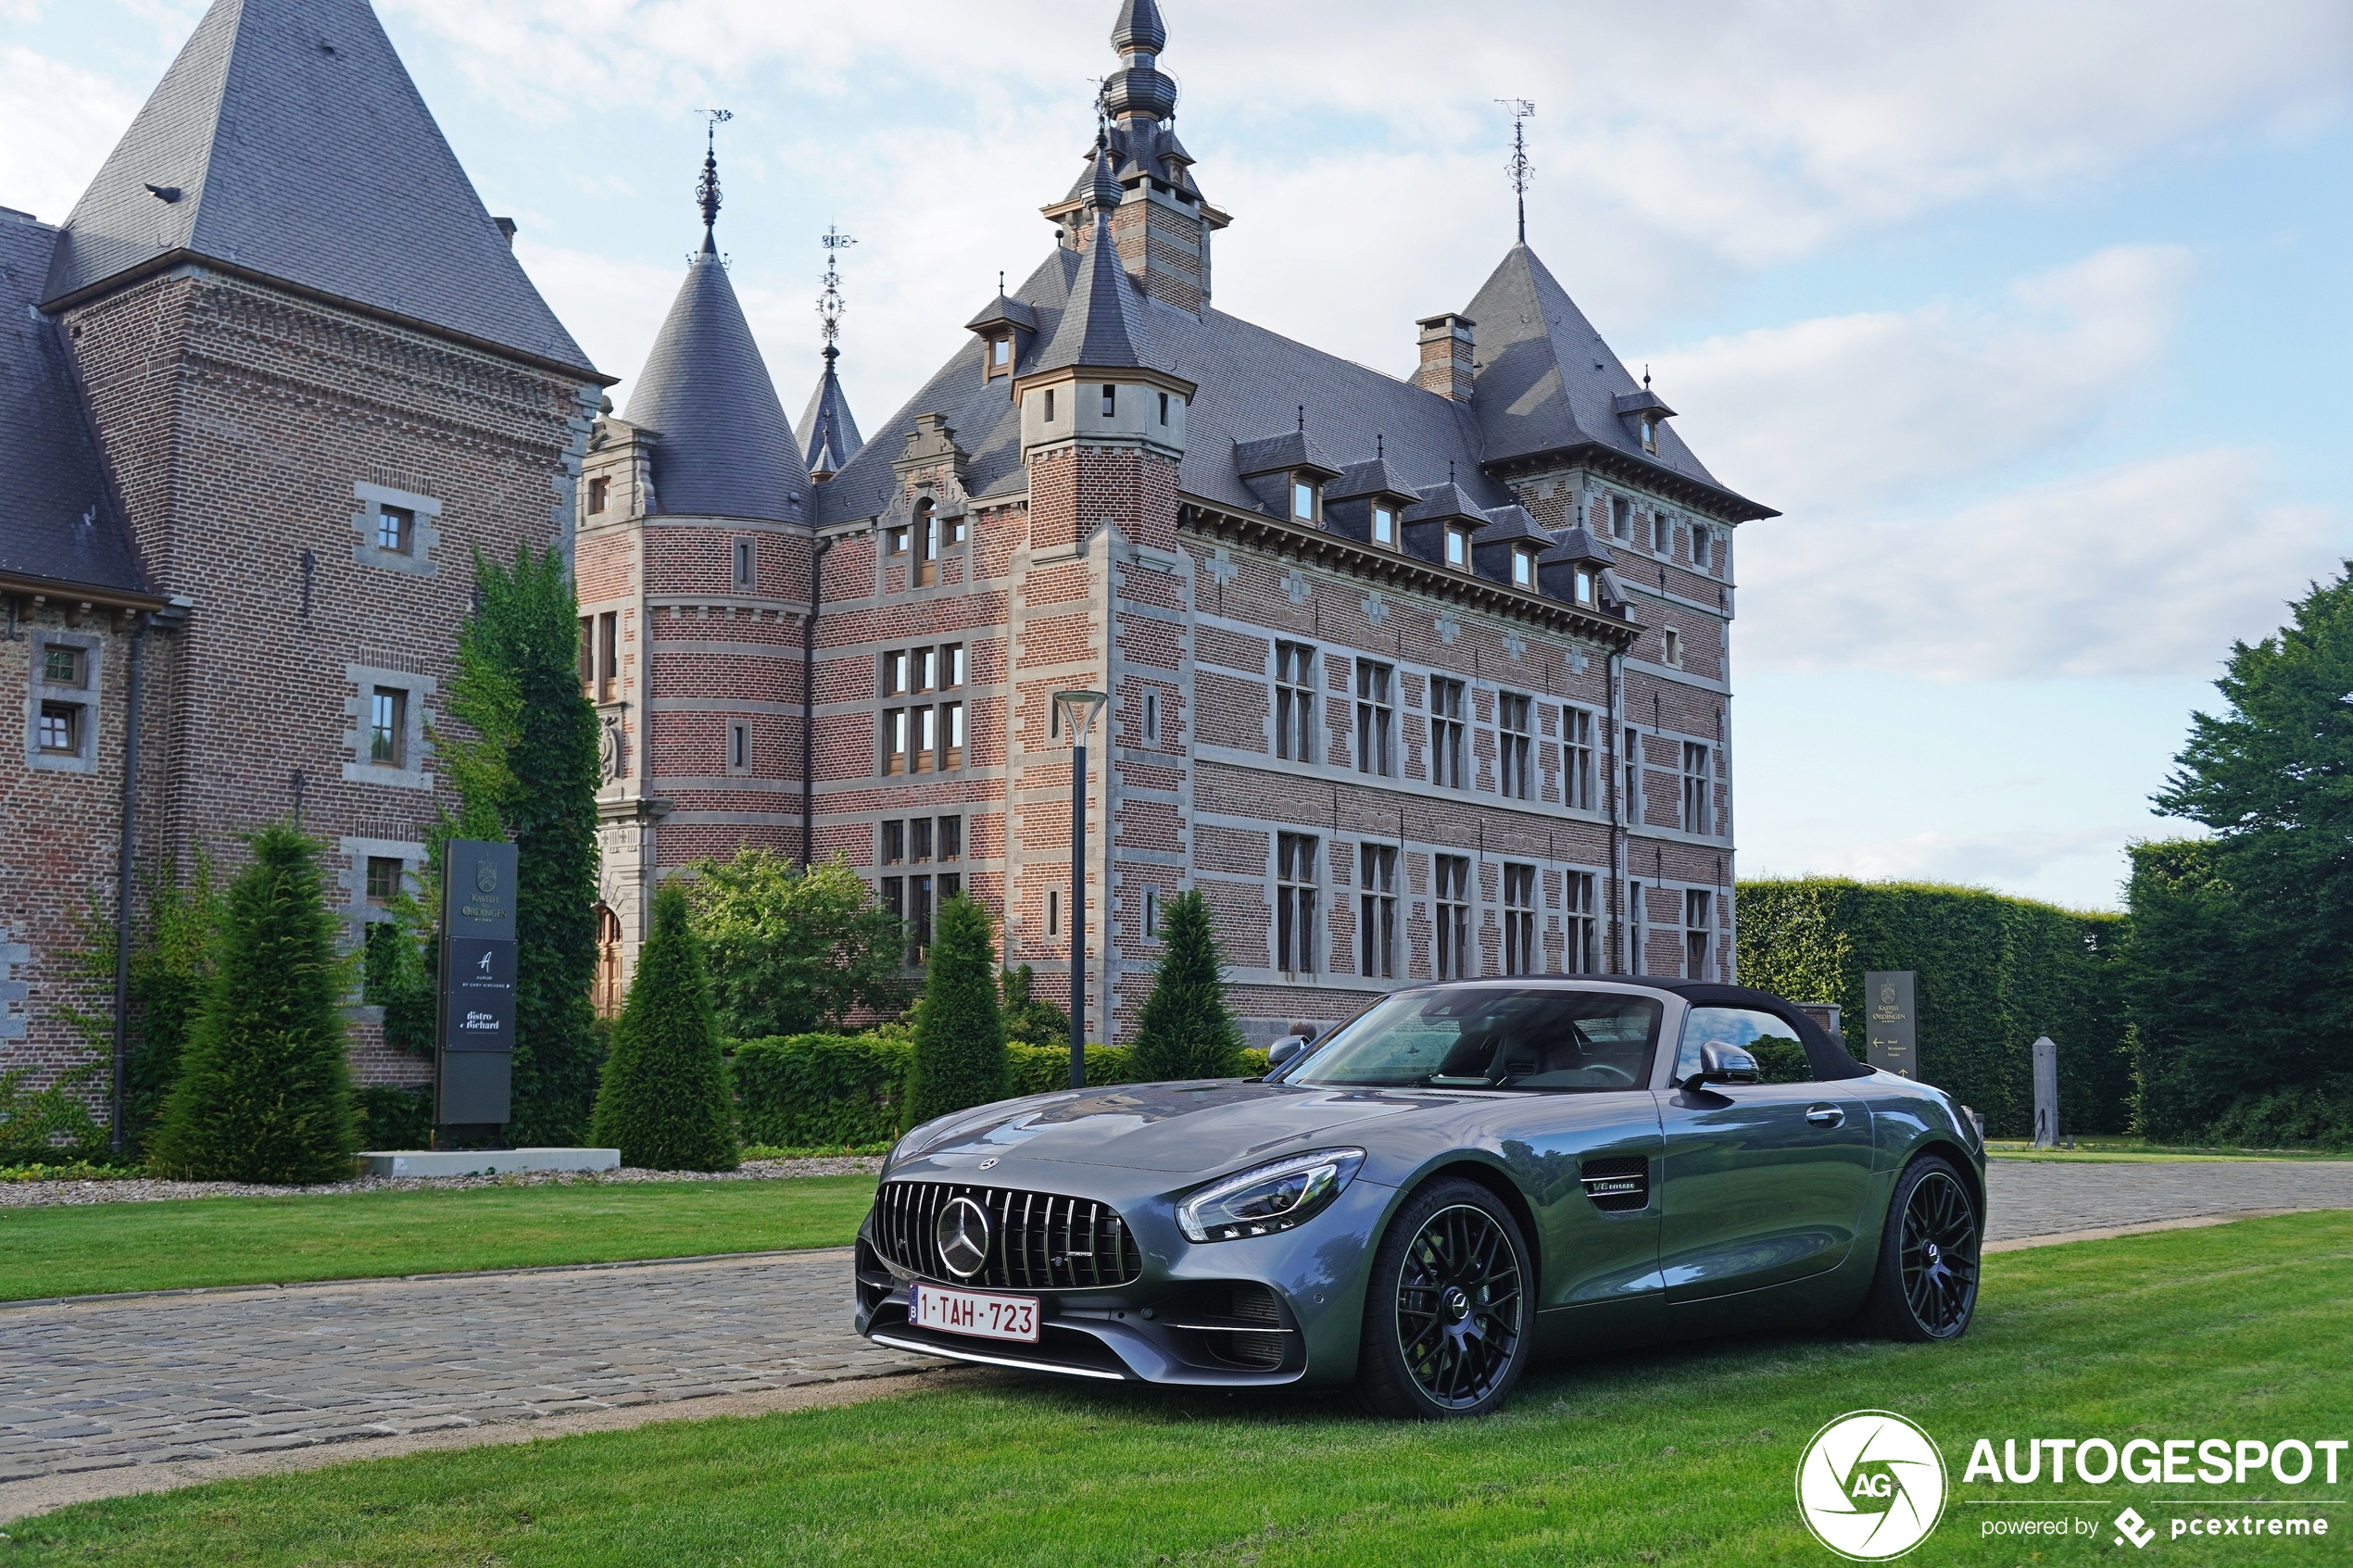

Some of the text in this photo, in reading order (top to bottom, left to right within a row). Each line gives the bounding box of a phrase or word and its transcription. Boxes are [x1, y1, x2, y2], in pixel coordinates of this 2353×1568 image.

[467, 1010, 492, 1021] Bistro
[466, 1020, 499, 1030] Richard
[1592, 1182, 1609, 1191] V8
[911, 1293, 1033, 1335] B 1-TAH-723
